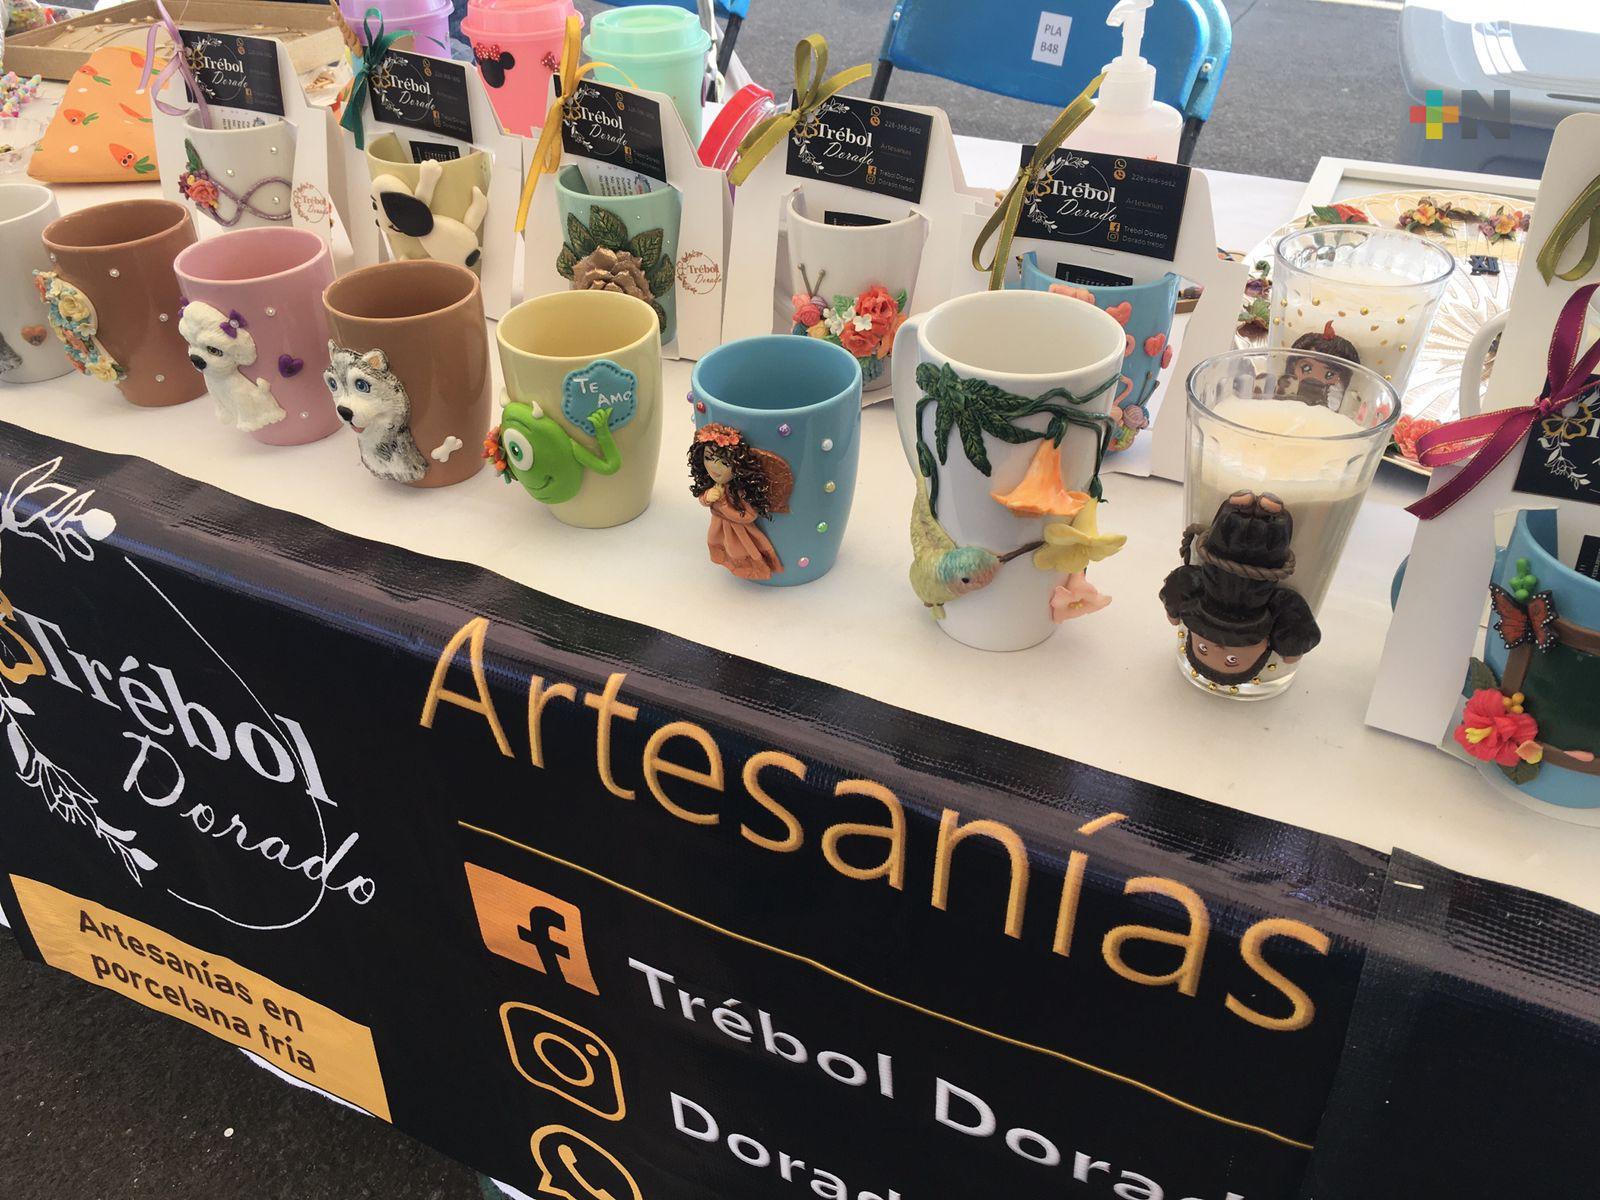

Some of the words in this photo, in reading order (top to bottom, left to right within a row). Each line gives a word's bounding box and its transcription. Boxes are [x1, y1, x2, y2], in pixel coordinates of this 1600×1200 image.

[1044, 24, 1062, 37] PLA
[1040, 42, 1059, 54] B48
[204, 56, 244, 74] Trébol
[211, 71, 248, 88] Dorado
[390, 75, 432, 95] Trébol
[399, 91, 436, 110] Dorado
[580, 106, 623, 130] Trébol
[589, 124, 628, 146] Dorado
[817, 122, 873, 148] Trébol
[823, 142, 875, 165] Dorado
[1050, 180, 1116, 204] Trébol
[1056, 199, 1117, 222] Dorado
[597, 391, 632, 408] AMO
[12, 607, 338, 807] Trébol
[123, 731, 375, 905] Dorado
[419, 617, 1332, 1033] Artesanías
[80, 909, 253, 1005] Artesanías
[262, 997, 304, 1033] en
[91, 953, 251, 1039] porcelana
[258, 1023, 317, 1074] fría
[628, 956, 895, 1100] Trébol
[935, 1077, 1245, 1200] Dora
[670, 1091, 901, 1200] Dora
